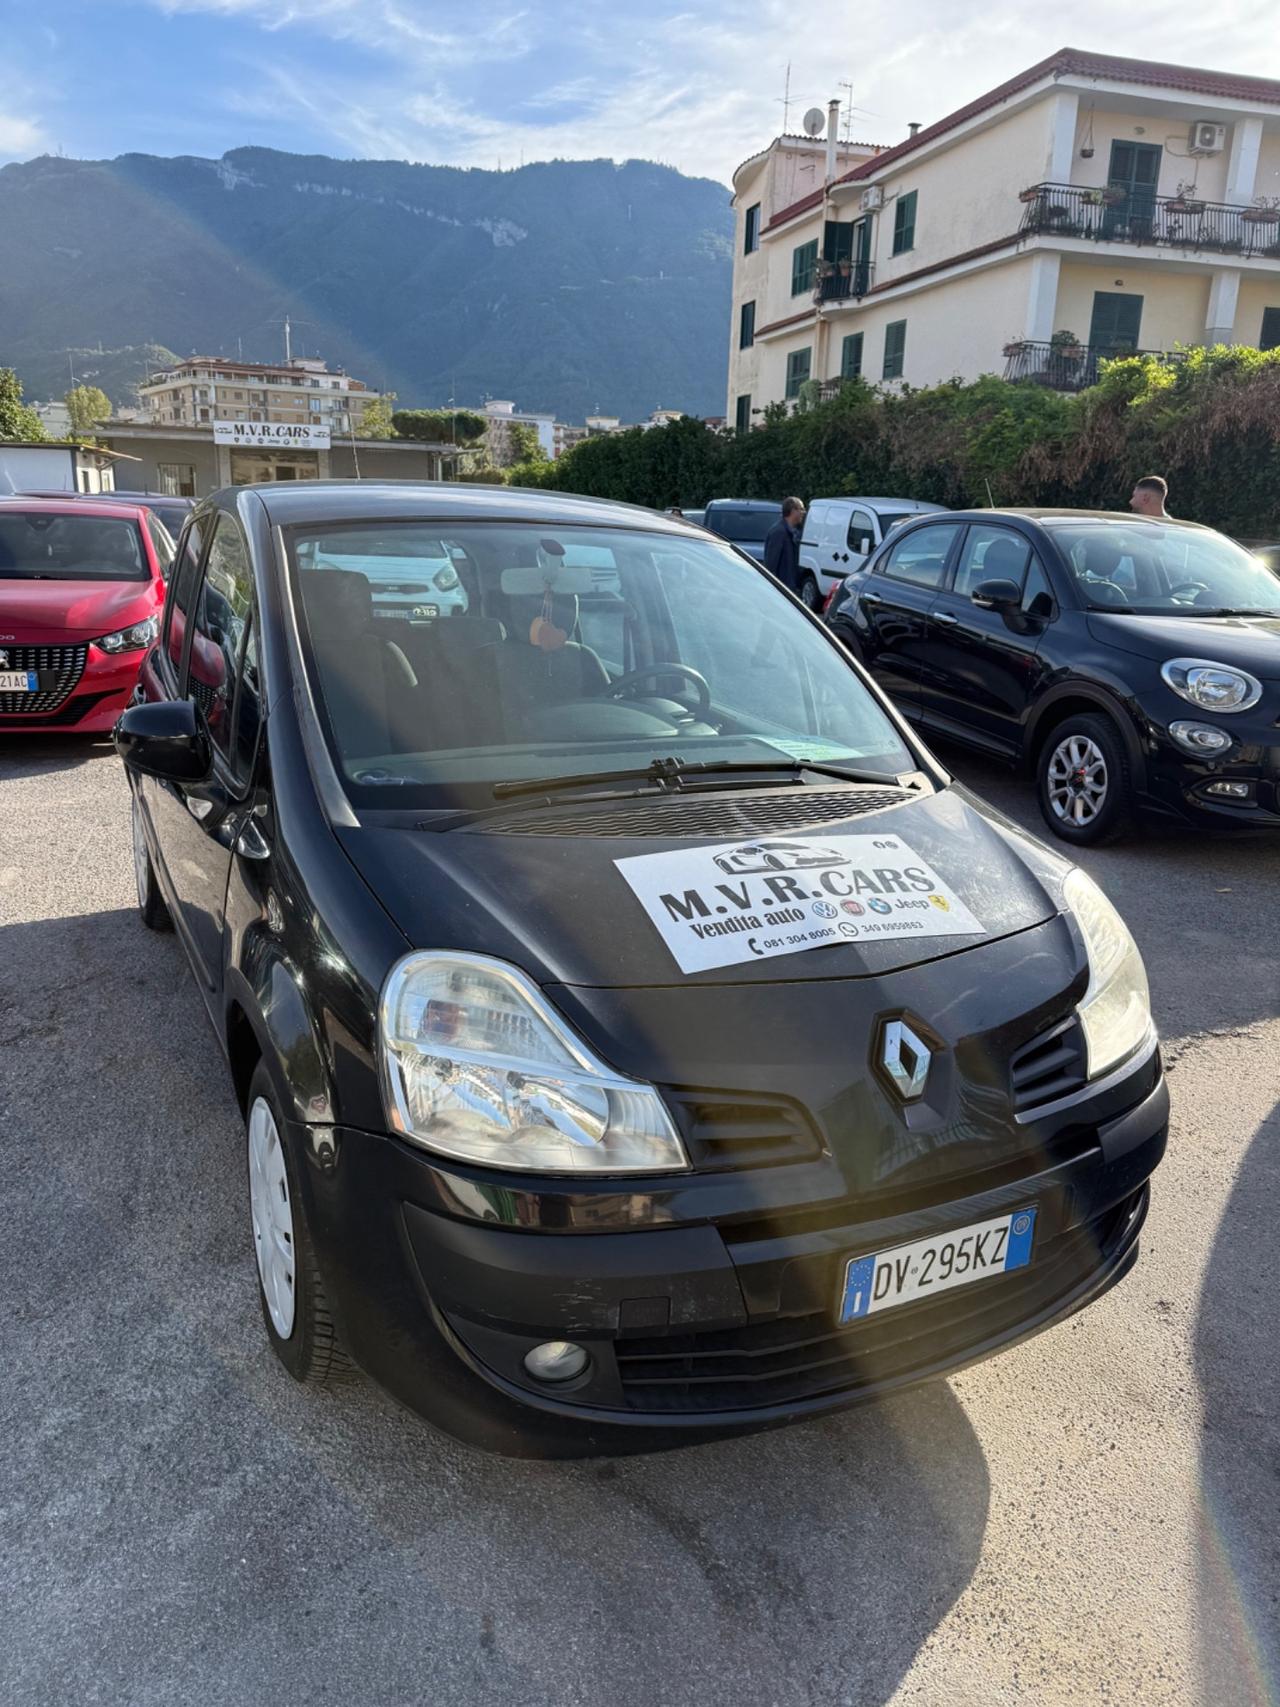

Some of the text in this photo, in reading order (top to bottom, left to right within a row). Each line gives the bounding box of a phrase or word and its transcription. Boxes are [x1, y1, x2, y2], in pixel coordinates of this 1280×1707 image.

[894, 898, 930, 911] Jeep
[689, 906, 806, 939] Vendita auto
[764, 927, 836, 949] 081 304 8005
